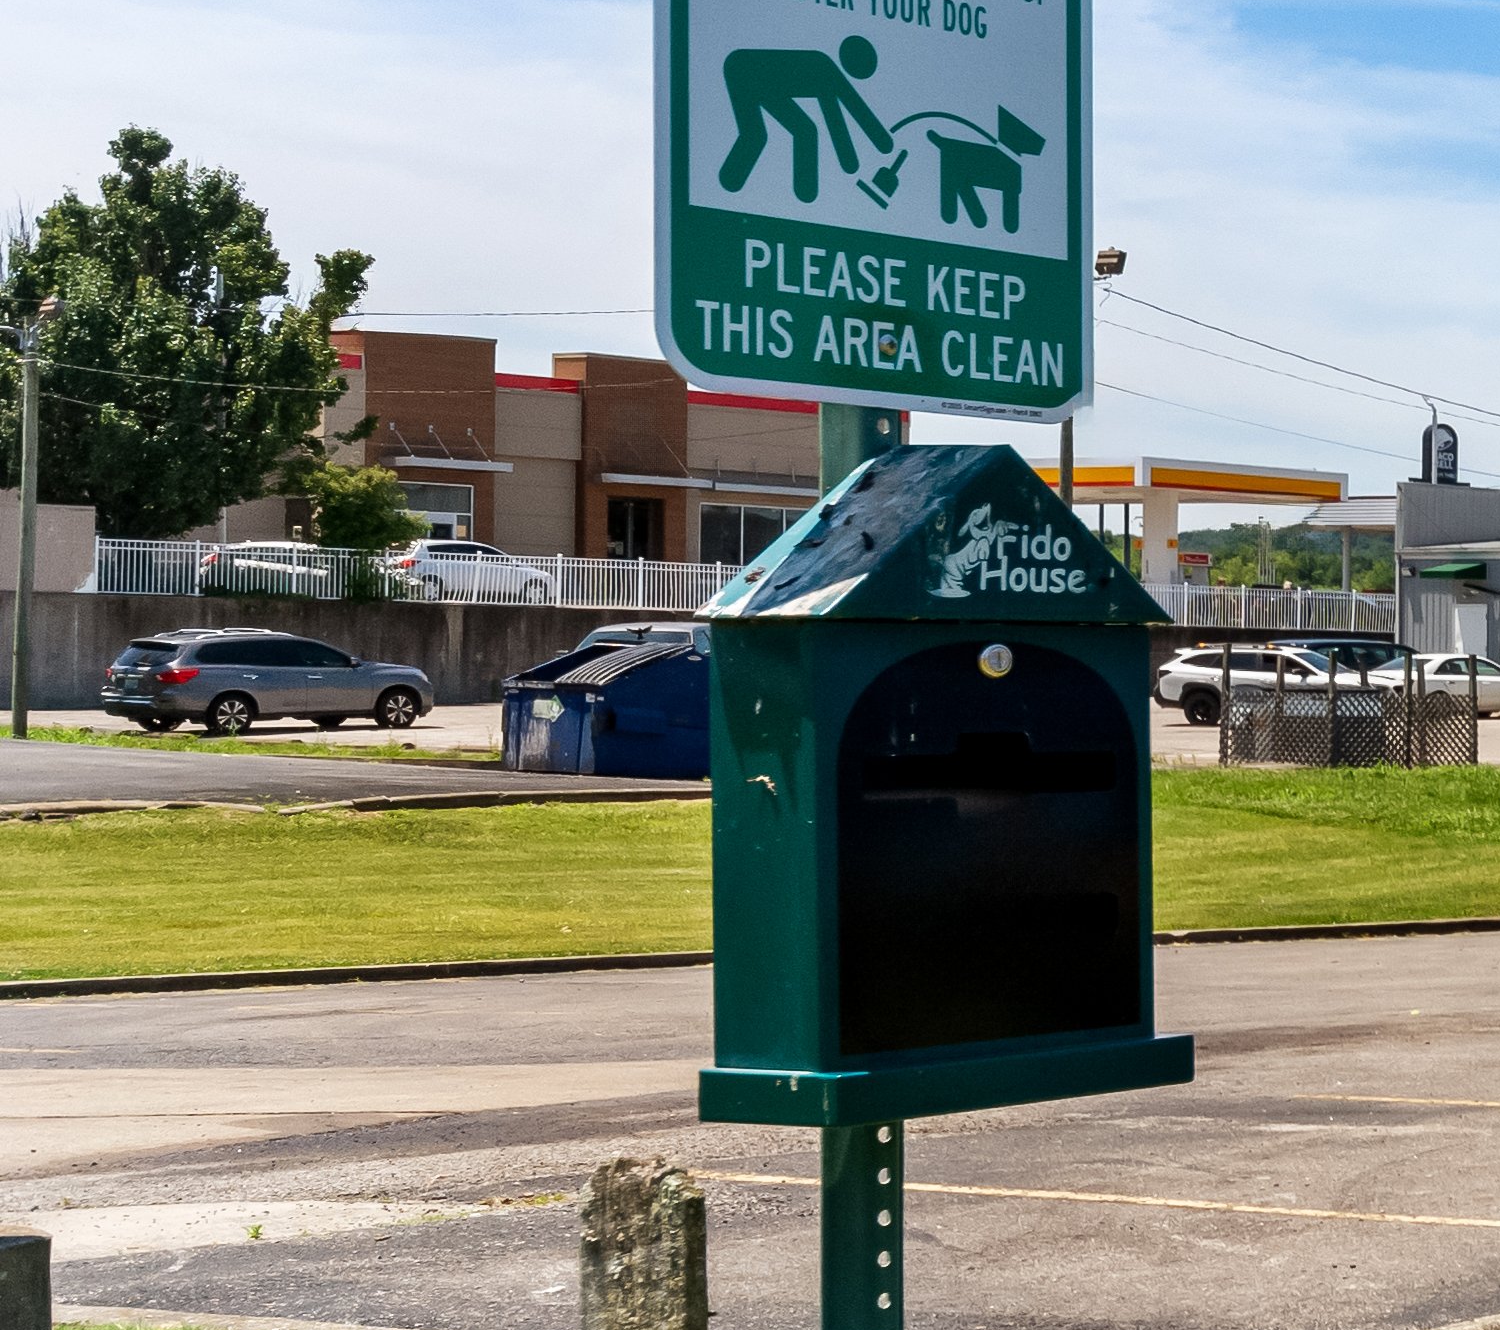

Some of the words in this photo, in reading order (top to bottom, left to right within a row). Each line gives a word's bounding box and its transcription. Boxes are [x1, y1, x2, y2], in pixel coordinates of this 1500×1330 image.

[745, 239, 906, 307] PLEASE
[927, 264, 1026, 320] KEEP
[695, 299, 793, 359] THIS
[813, 315, 922, 373] AREA
[941, 330, 1063, 388] CLEAN
[997, 523, 1072, 562] Fido
[979, 555, 1087, 594] House
